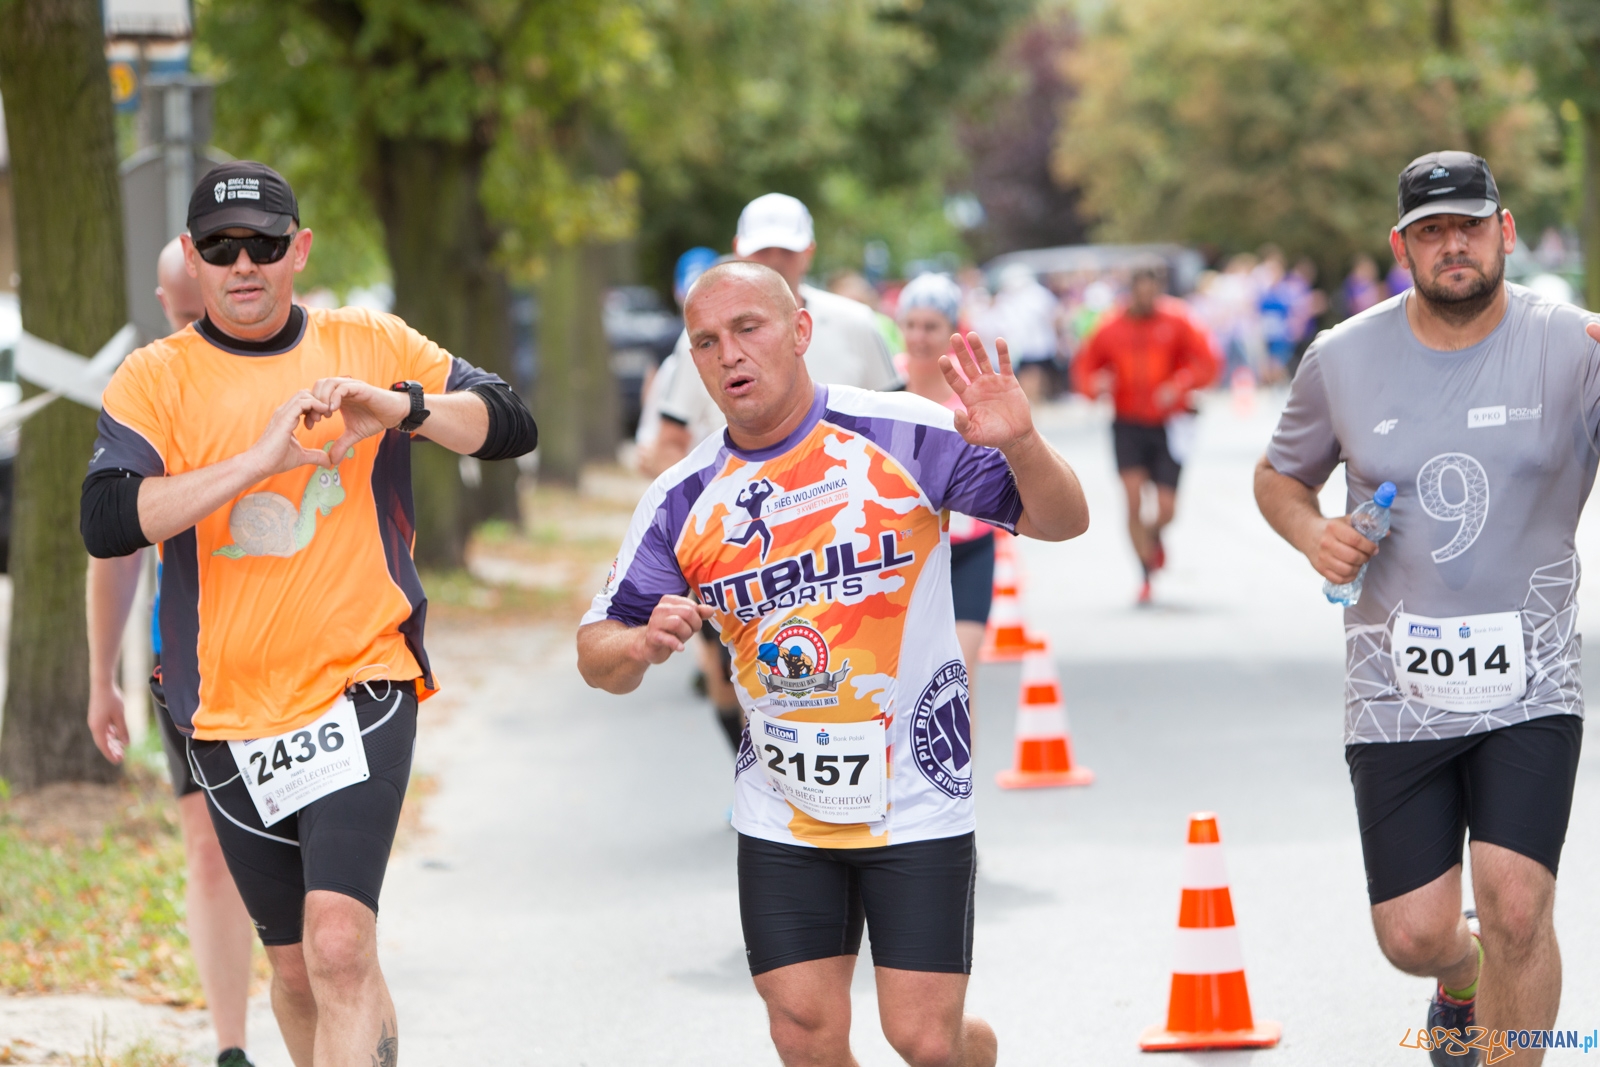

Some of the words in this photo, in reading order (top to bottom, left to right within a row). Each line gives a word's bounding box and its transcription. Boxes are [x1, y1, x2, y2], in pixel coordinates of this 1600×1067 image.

[1373, 419, 1398, 435] 4F
[1482, 412, 1500, 421] PKO
[793, 478, 848, 503] WOJOWNIKA
[834, 491, 849, 502] 2016
[1416, 452, 1490, 564] 9
[700, 534, 913, 612] PITBULL
[736, 577, 863, 623] SPORTS
[1405, 644, 1511, 676] 2014
[823, 697, 838, 706] BOKS
[1437, 686, 1460, 695] BIEG
[1463, 683, 1513, 695] LECHITÓW
[249, 722, 344, 786] 2436
[916, 735, 931, 762] PIT
[764, 743, 870, 786] 2157
[275, 787, 285, 799] 39
[285, 775, 304, 795] BIEG
[304, 757, 351, 783] LECHITÓW
[802, 786, 824, 794] MARCIN
[795, 789, 816, 803] BIEG
[818, 794, 873, 805] LECHITÓW
